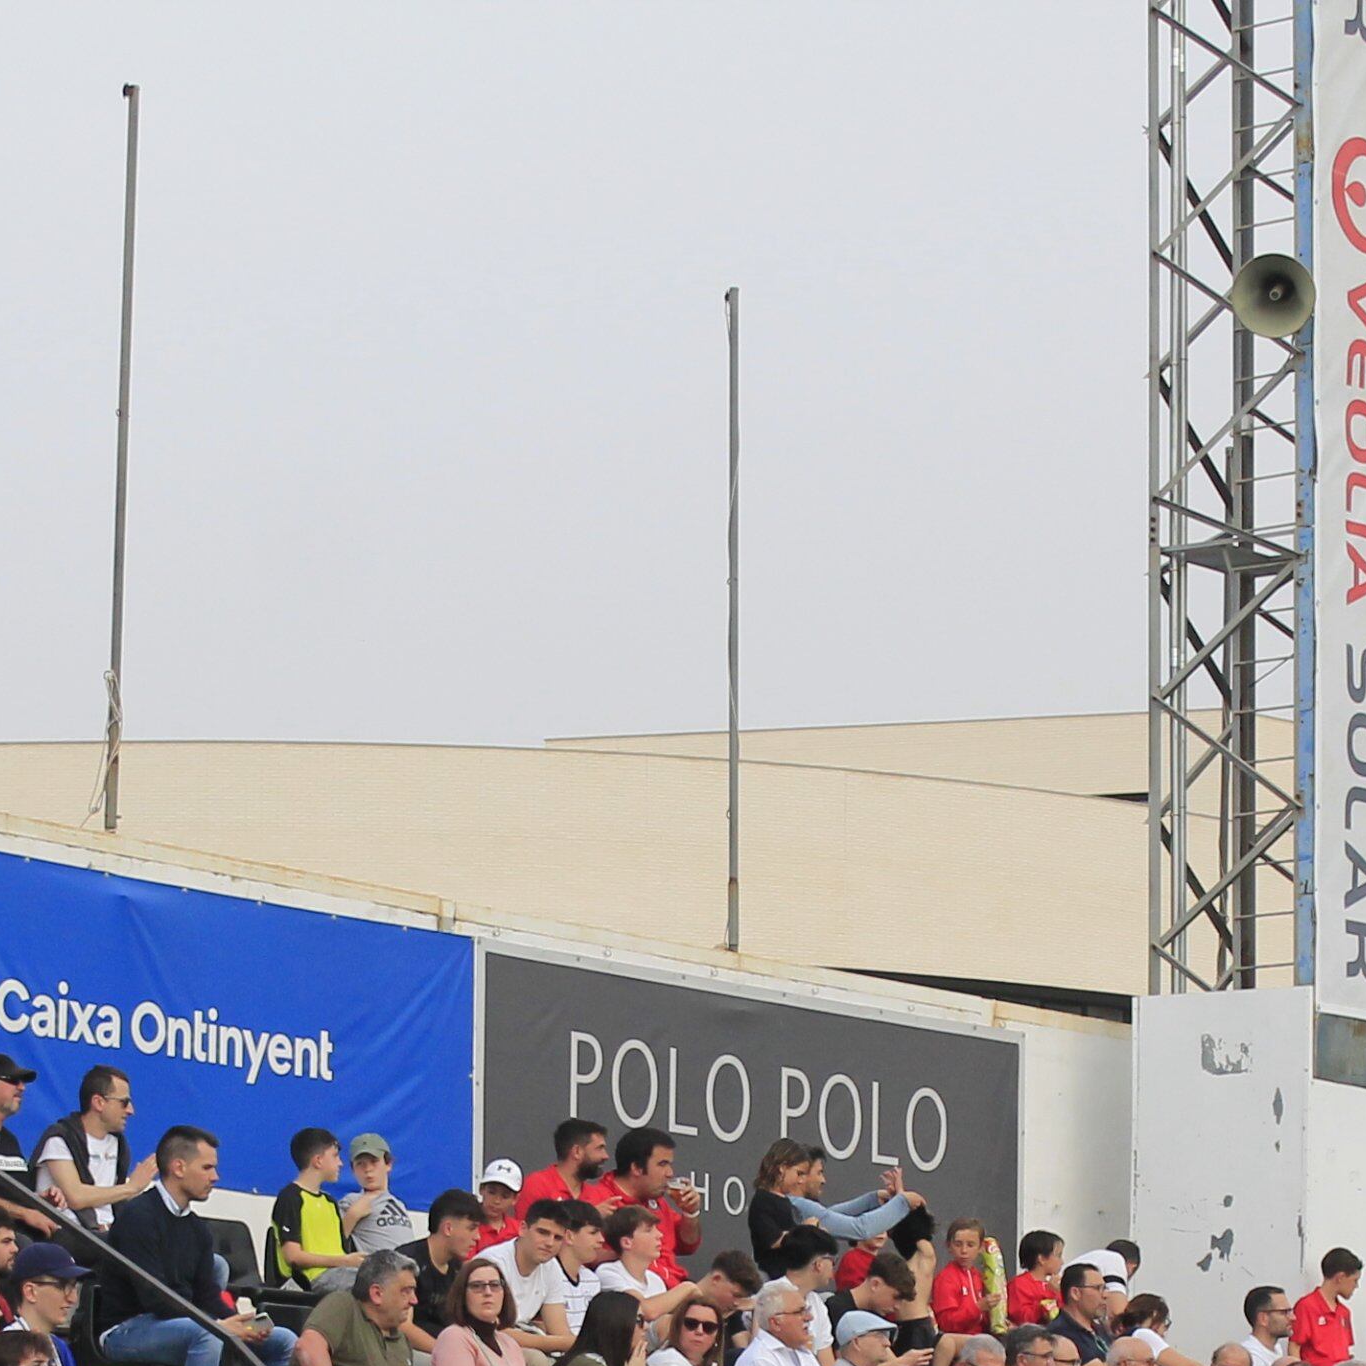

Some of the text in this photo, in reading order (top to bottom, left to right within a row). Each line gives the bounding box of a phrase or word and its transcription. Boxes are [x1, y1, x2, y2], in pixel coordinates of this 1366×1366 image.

[131, 1001, 335, 1085] Ontinyent
[570, 1030, 949, 1172] POLO POLO
